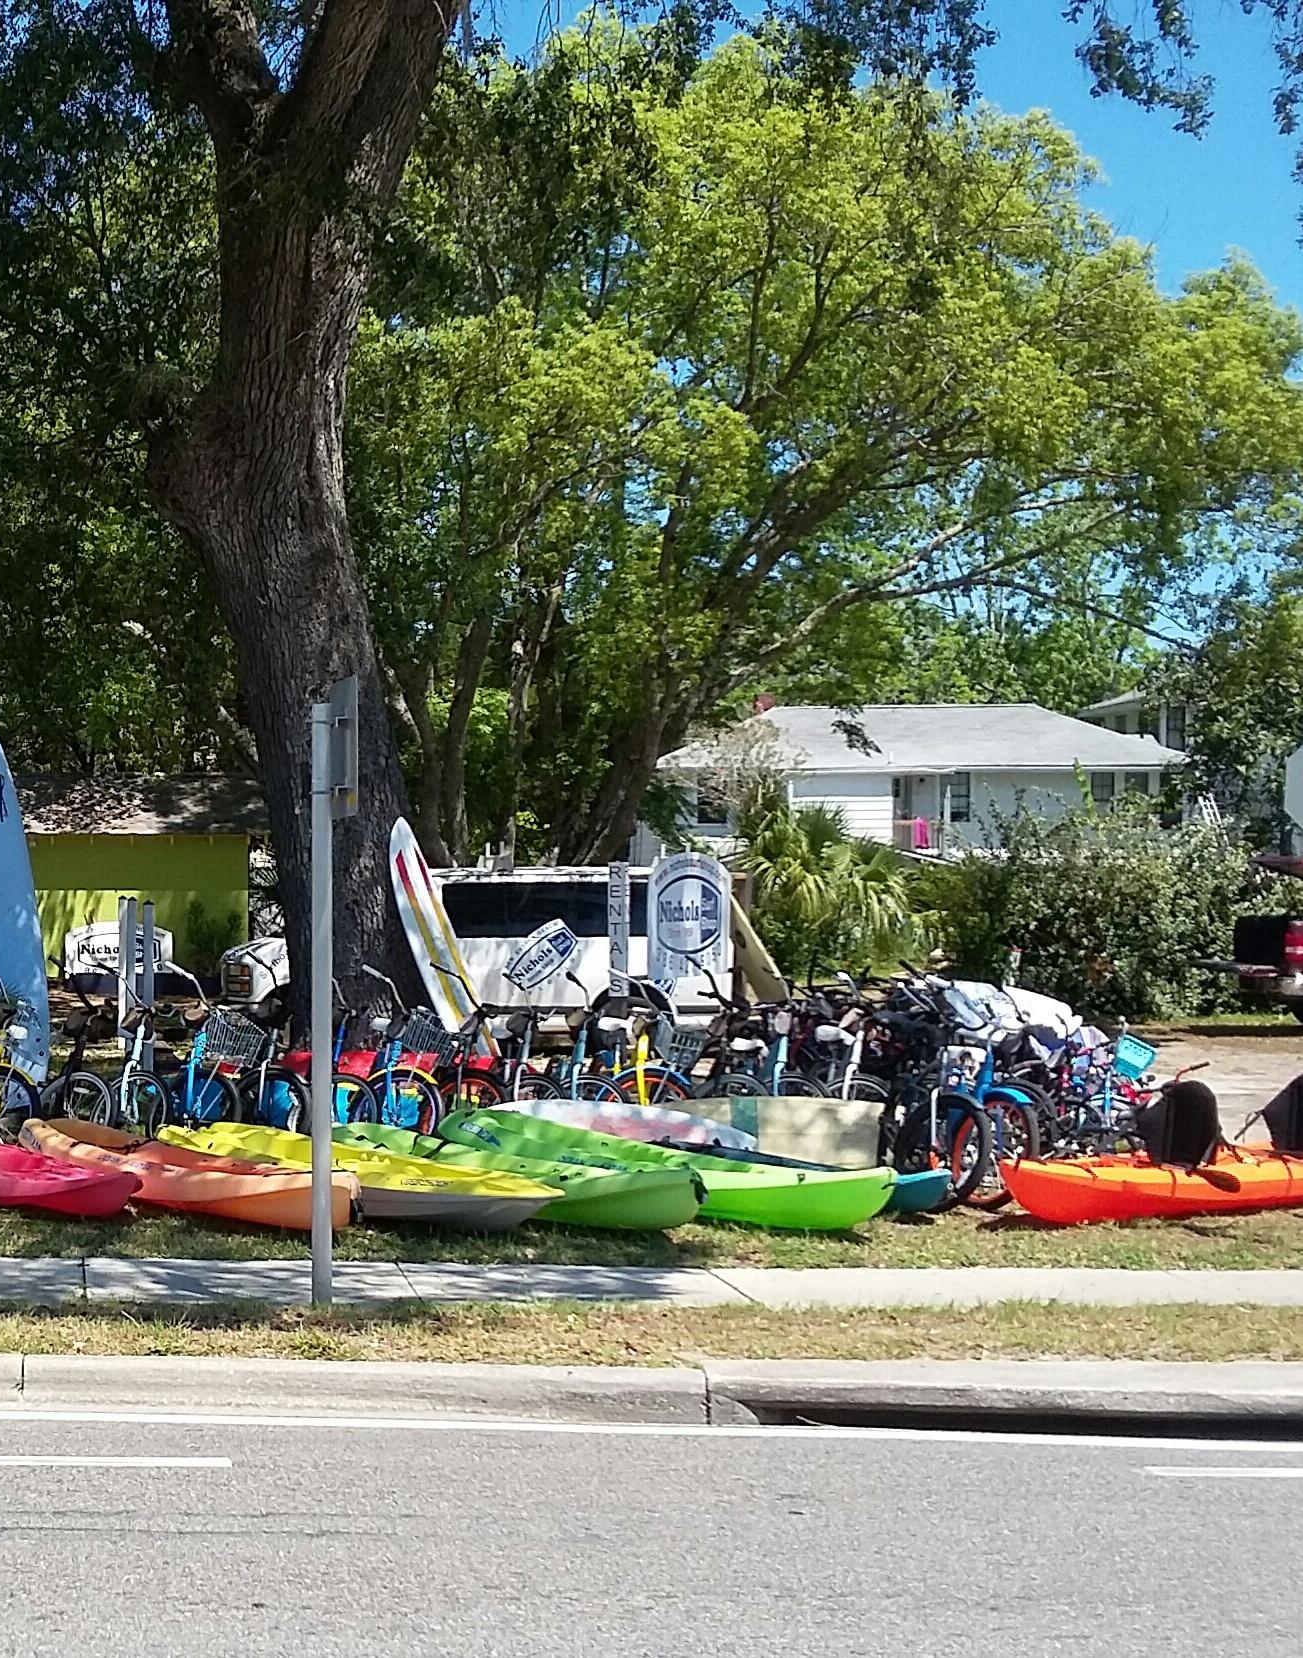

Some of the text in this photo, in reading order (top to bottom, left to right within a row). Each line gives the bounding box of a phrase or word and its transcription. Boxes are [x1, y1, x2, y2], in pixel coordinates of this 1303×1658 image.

[659, 900, 699, 924] Nichols
[80, 943, 120, 955] Nicho
[514, 947, 553, 981] Nichols
